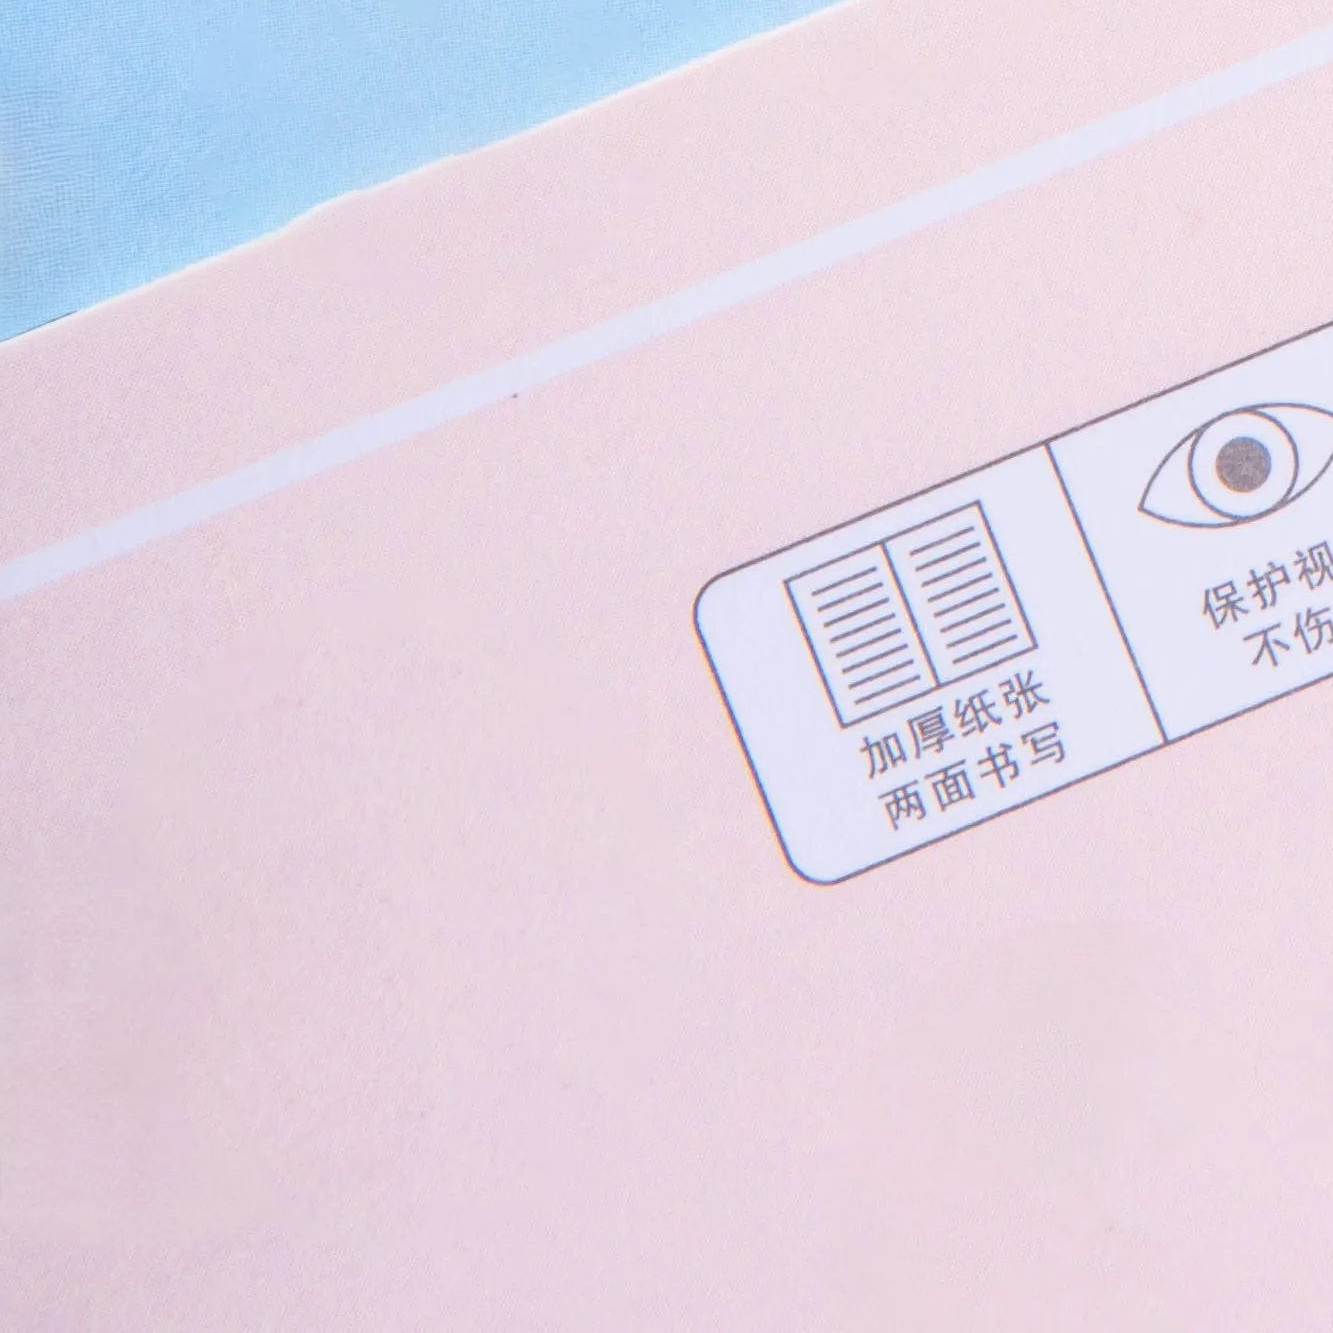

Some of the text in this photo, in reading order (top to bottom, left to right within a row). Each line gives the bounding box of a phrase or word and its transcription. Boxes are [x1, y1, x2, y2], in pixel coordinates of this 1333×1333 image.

[859, 670, 1051, 780] 加厚纸张
[877, 721, 1067, 831] 两面书写
